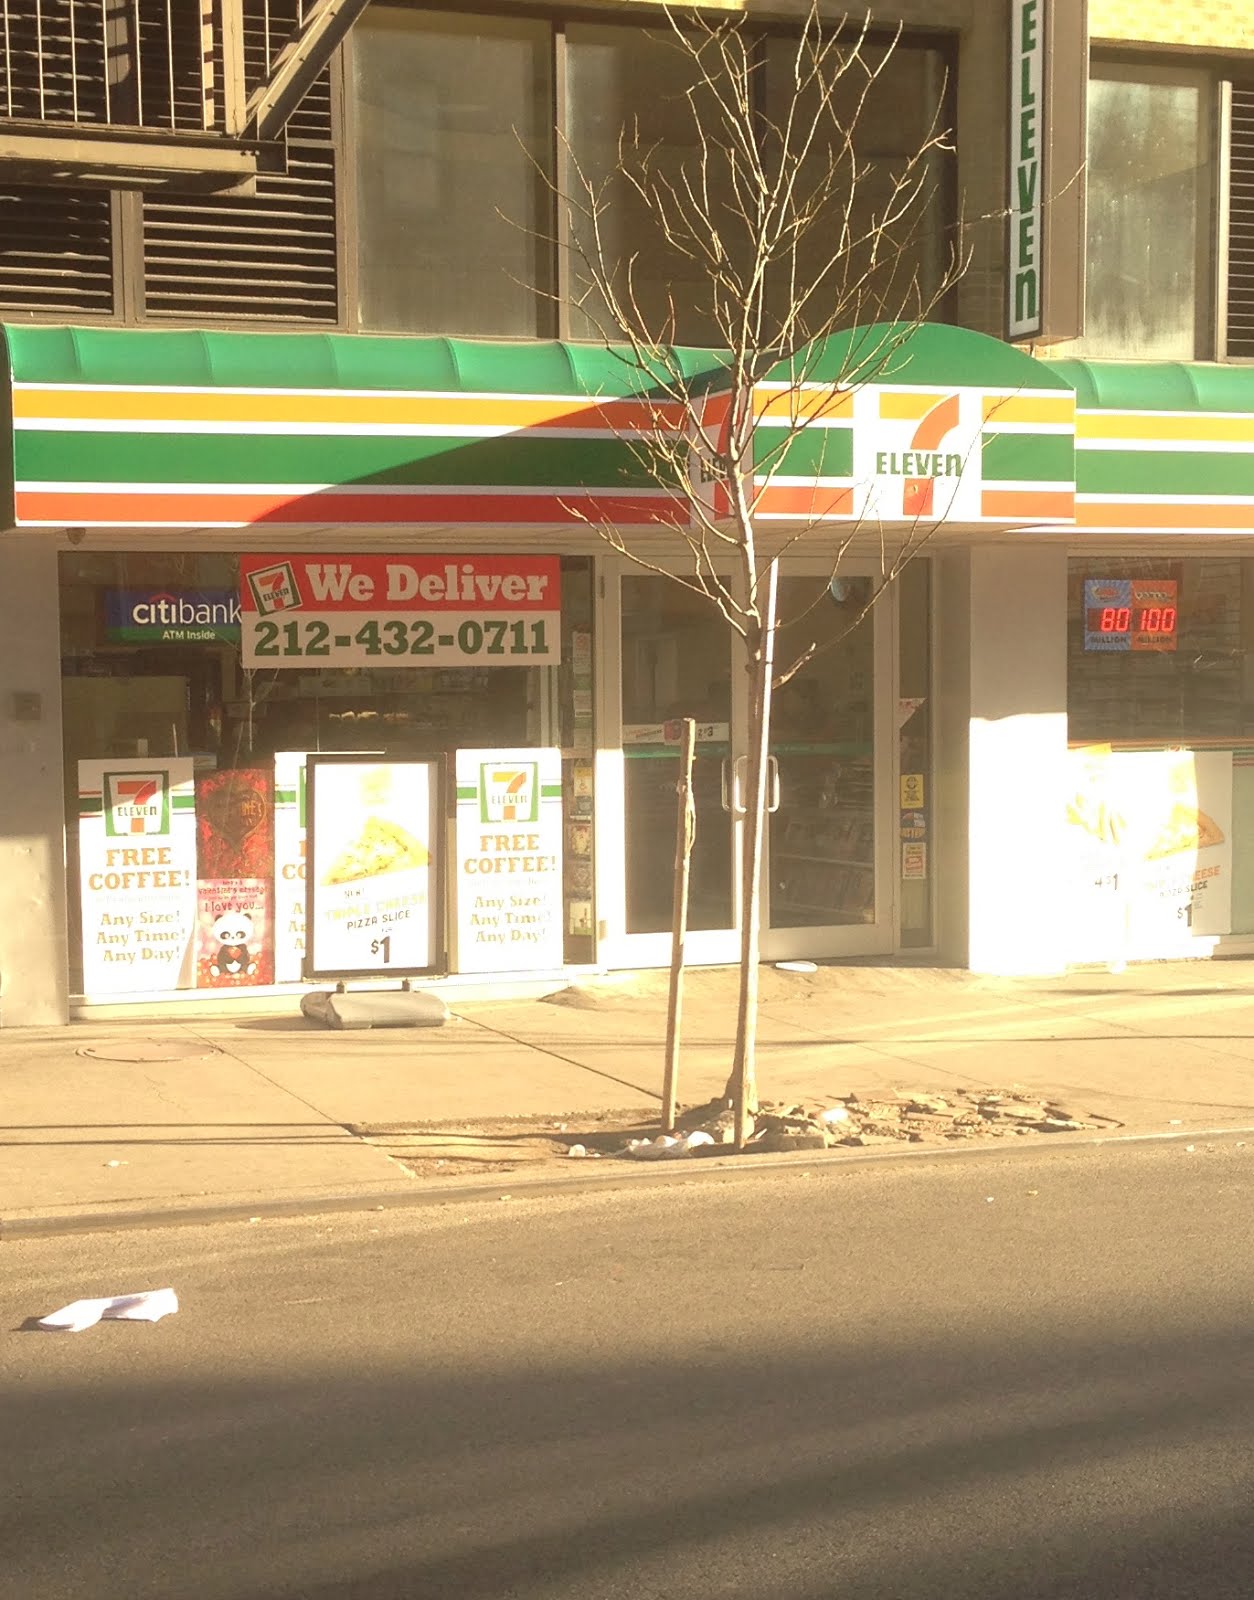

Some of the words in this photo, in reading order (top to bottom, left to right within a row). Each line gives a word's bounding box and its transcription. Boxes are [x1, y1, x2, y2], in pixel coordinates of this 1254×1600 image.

[879, 391, 960, 515] 7
[305, 564, 374, 601] We
[386, 564, 547, 601] Deliver
[132, 598, 242, 624] citibank
[1101, 607, 1130, 632] 80
[1140, 607, 1175, 632] 100
[162, 630, 184, 640] ATM
[187, 630, 216, 640] Inside
[254, 620, 549, 656] 212-432-0711
[117, 780, 157, 833] 7
[479, 833, 539, 852] FREE
[106, 847, 171, 867] FREE
[463, 855, 555, 874] COFFEE!
[88, 869, 190, 890] COFFEE!
[1185, 880, 1208, 892] SLICE
[211, 901, 233, 912] love
[475, 896, 504, 911] Any
[101, 913, 134, 928] Any
[139, 910, 180, 924] Size!
[347, 915, 378, 931] PIZZA
[382, 910, 411, 923] SLICE
[471, 913, 500, 928] Any
[1177, 903, 1193, 927] $1
[96, 932, 129, 947] Any
[134, 927, 186, 942] Time!
[476, 931, 505, 944] Any
[103, 950, 136, 965] Any
[141, 946, 180, 962] Day!
[371, 936, 391, 964] $1
